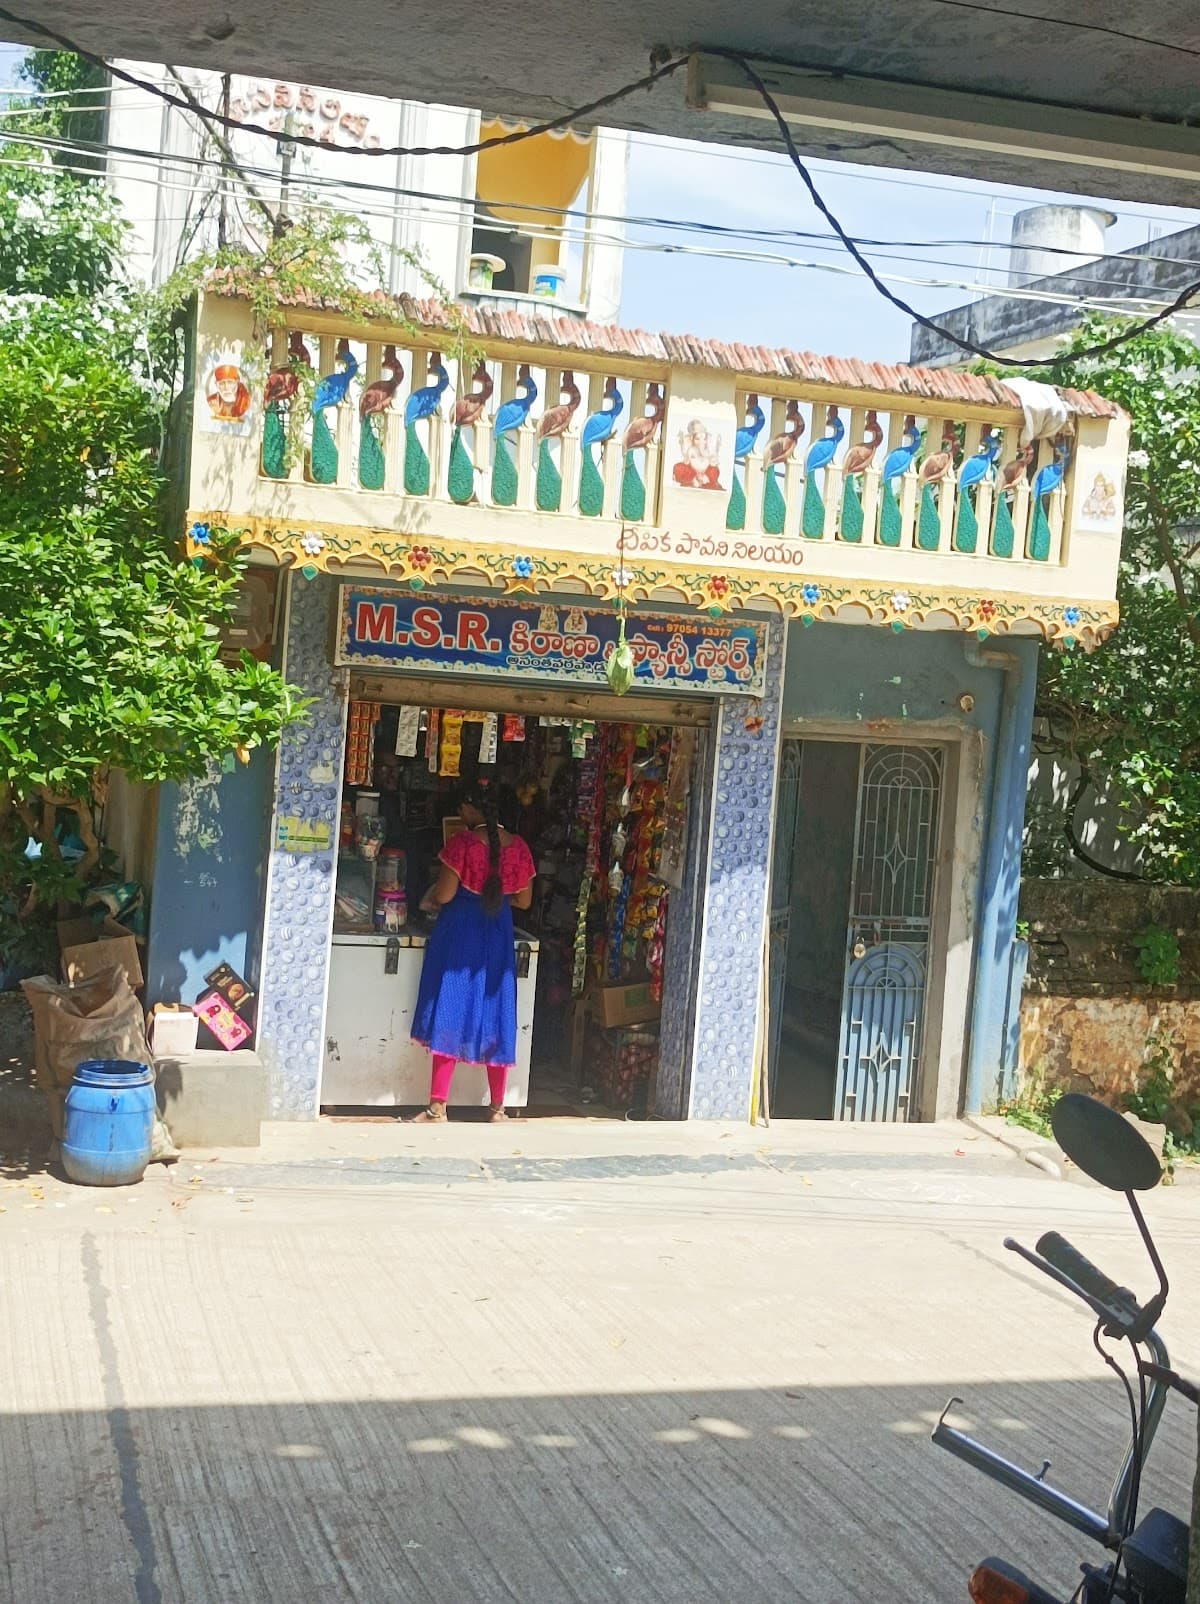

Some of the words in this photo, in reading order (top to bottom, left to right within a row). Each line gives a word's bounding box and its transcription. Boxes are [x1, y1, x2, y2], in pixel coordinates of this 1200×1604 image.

[675, 532, 728, 557] పావని
[732, 541, 804, 566] నిలయం
[356, 602, 501, 652] M.S.R.
[510, 620, 600, 658] కిరాణా
[666, 623, 698, 635] 97054
[701, 626, 732, 637] 13377
